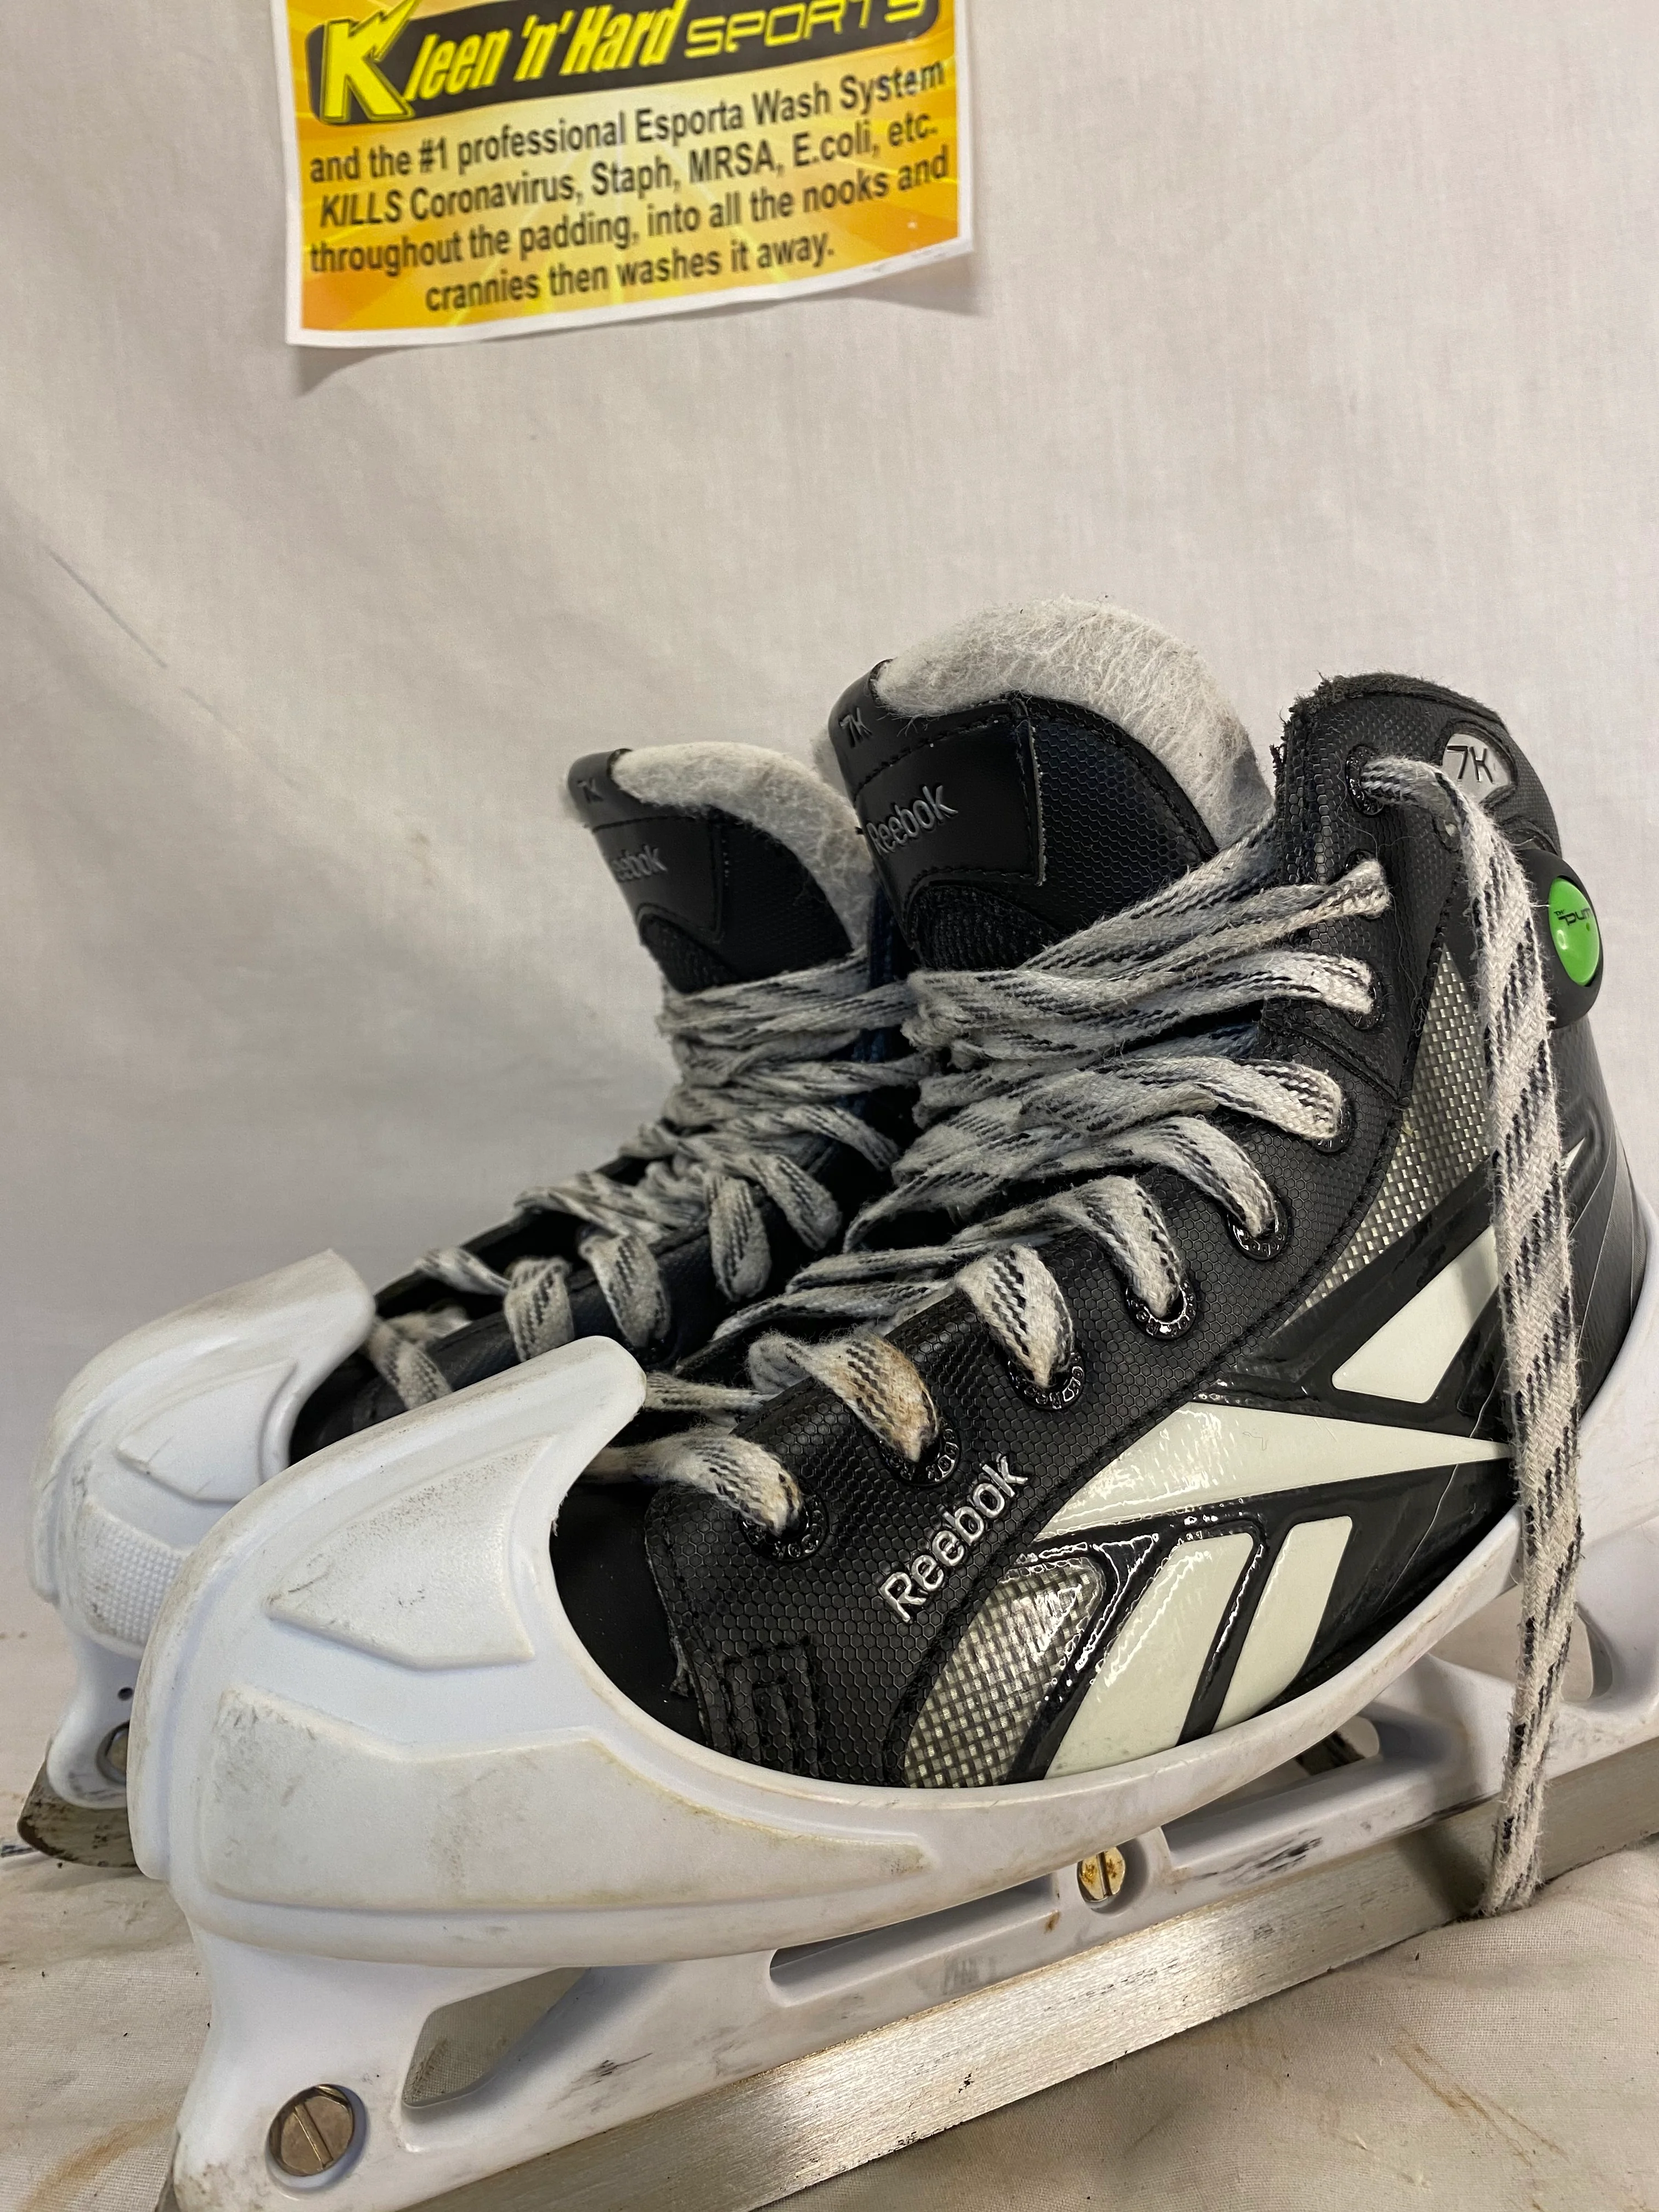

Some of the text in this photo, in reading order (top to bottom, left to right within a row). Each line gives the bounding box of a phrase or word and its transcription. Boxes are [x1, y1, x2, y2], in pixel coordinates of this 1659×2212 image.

[321, 0, 511, 122] Kleen
[560, 0, 687, 76] Hard
[684, 0, 926, 58] SPORTS
[310, 61, 945, 183] and the #1 professional Esporta Wash System
[320, 110, 938, 228] KILLS Coronavirus, Staph, MRSA, E.coli, etc.
[309, 145, 949, 276] throughout the padding, into all the nooks and
[425, 233, 834, 313] crannies then washes it away.
[839, 707, 873, 748] 7K
[1447, 744, 1495, 784] 7K
[866, 785, 959, 857] Reebok
[878, 1453, 1029, 1622] Reebok
